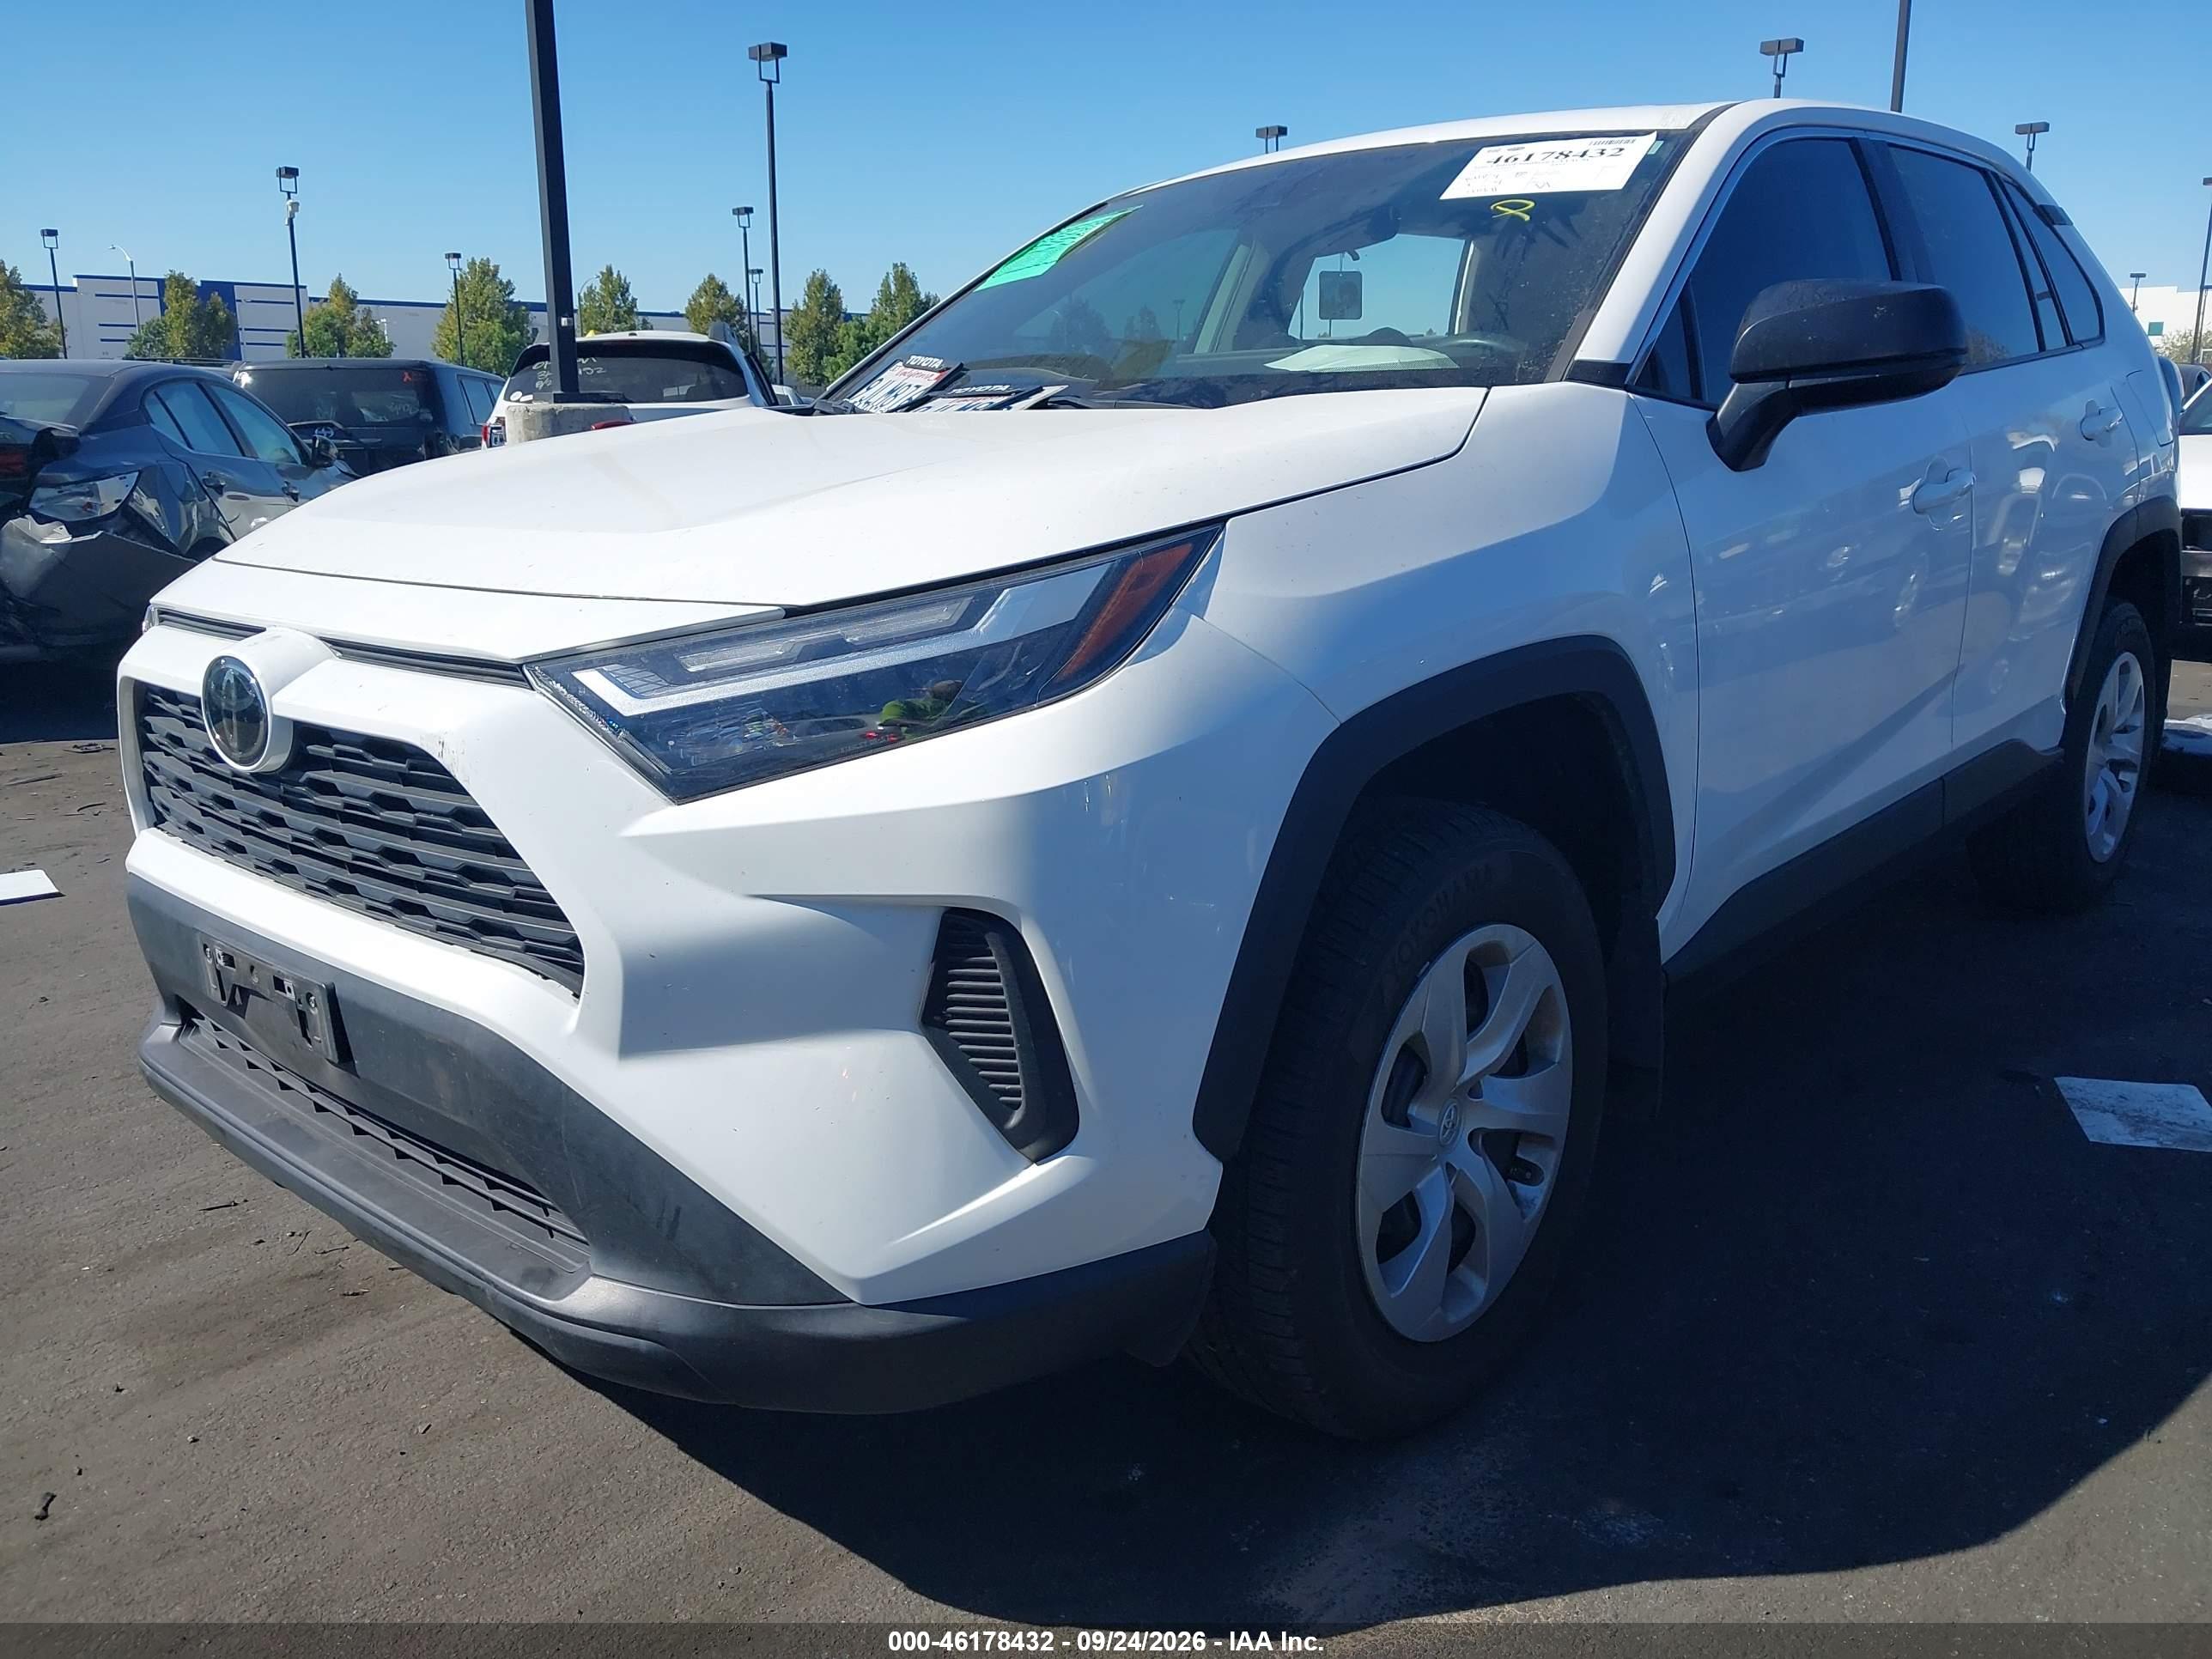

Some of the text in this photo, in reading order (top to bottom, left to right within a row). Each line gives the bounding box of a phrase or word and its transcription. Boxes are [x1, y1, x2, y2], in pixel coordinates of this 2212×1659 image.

[1486, 147, 1626, 164] 46178432
[906, 355, 944, 369] TOYOTA
[947, 385, 1011, 395] TOYOTA
